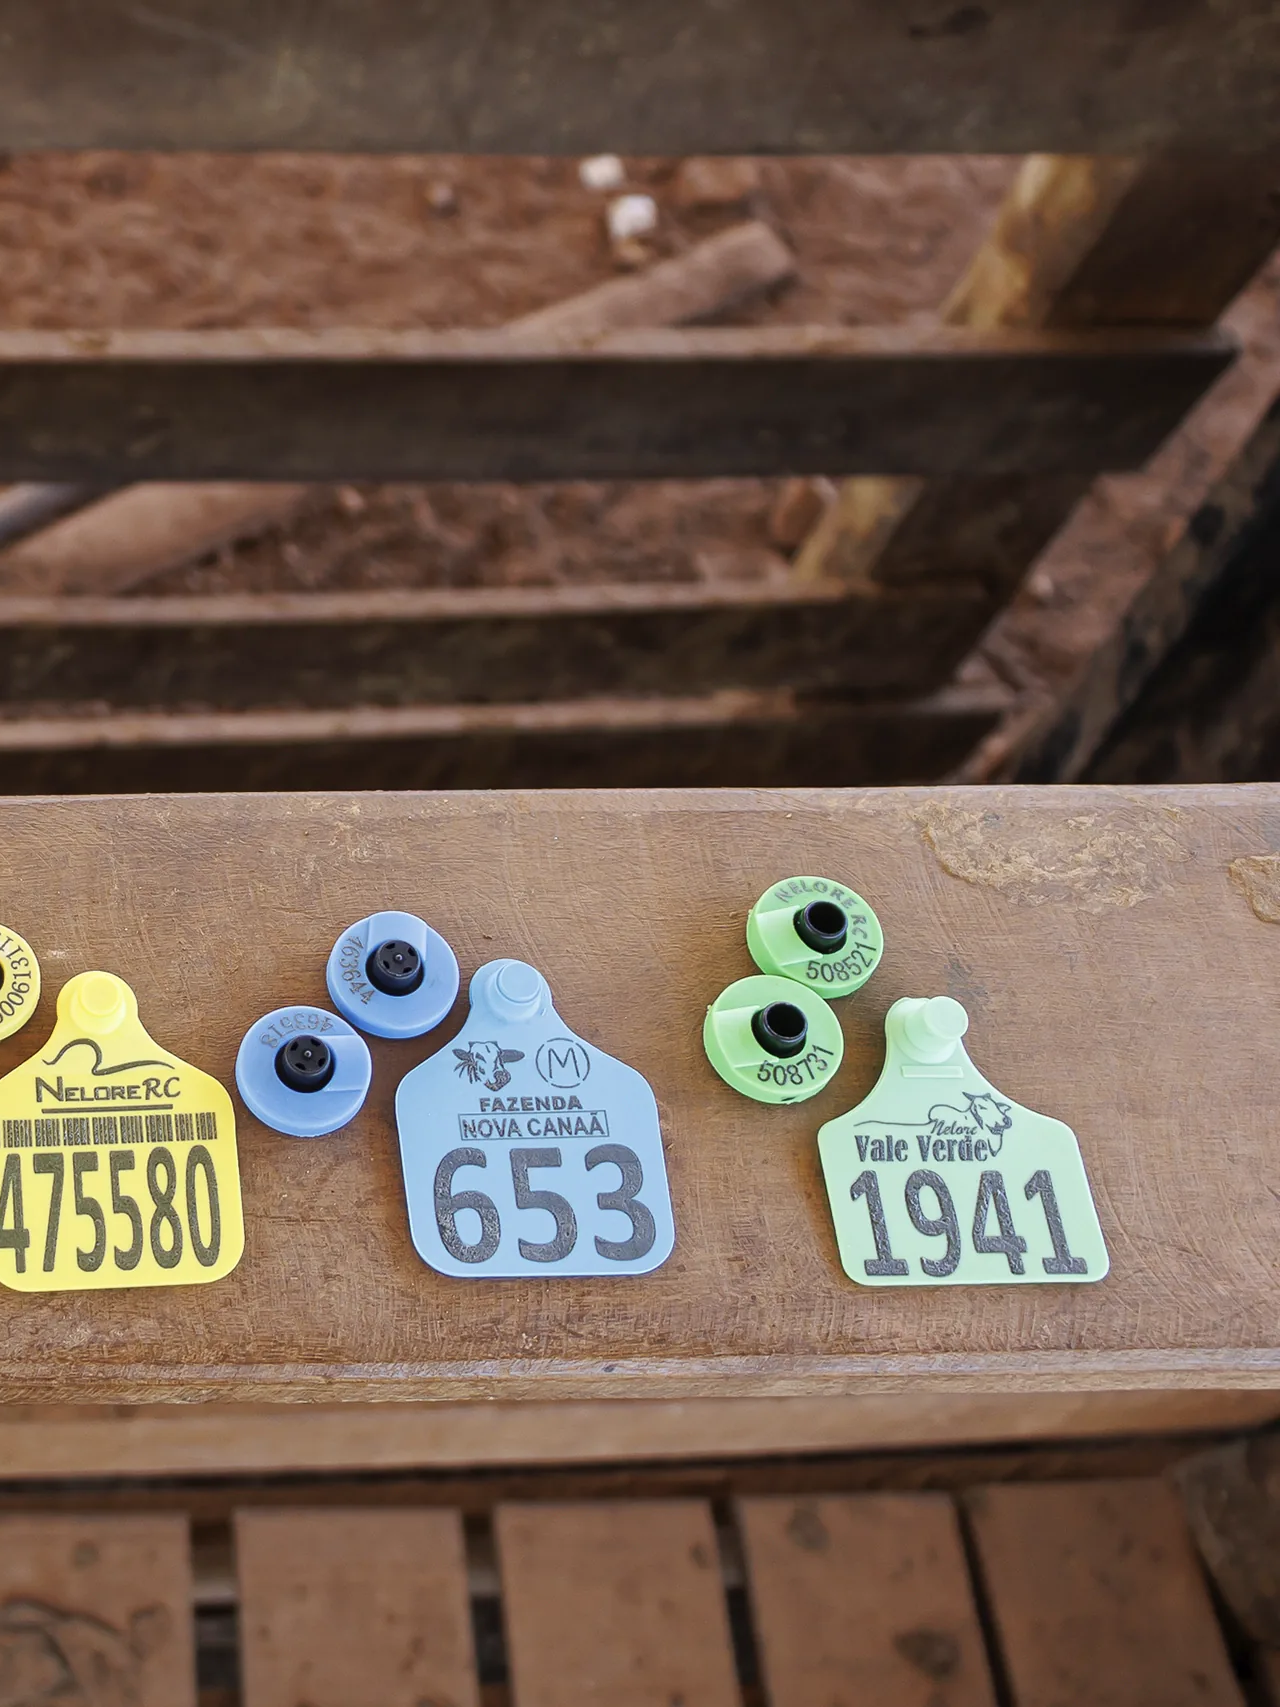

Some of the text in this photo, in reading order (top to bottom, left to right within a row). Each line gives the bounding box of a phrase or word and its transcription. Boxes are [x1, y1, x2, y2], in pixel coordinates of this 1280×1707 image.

[774, 879, 858, 909] NELORE
[805, 941, 877, 983] 508521
[757, 1044, 835, 1086] 508731
[479, 1095, 584, 1112] FAZENDA
[462, 1118, 523, 1138] NOVA
[929, 1118, 979, 1136] Nelore
[854, 1132, 989, 1163] Vale Verde
[433, 1143, 657, 1264] 653
[849, 1169, 1089, 1278] 1941
